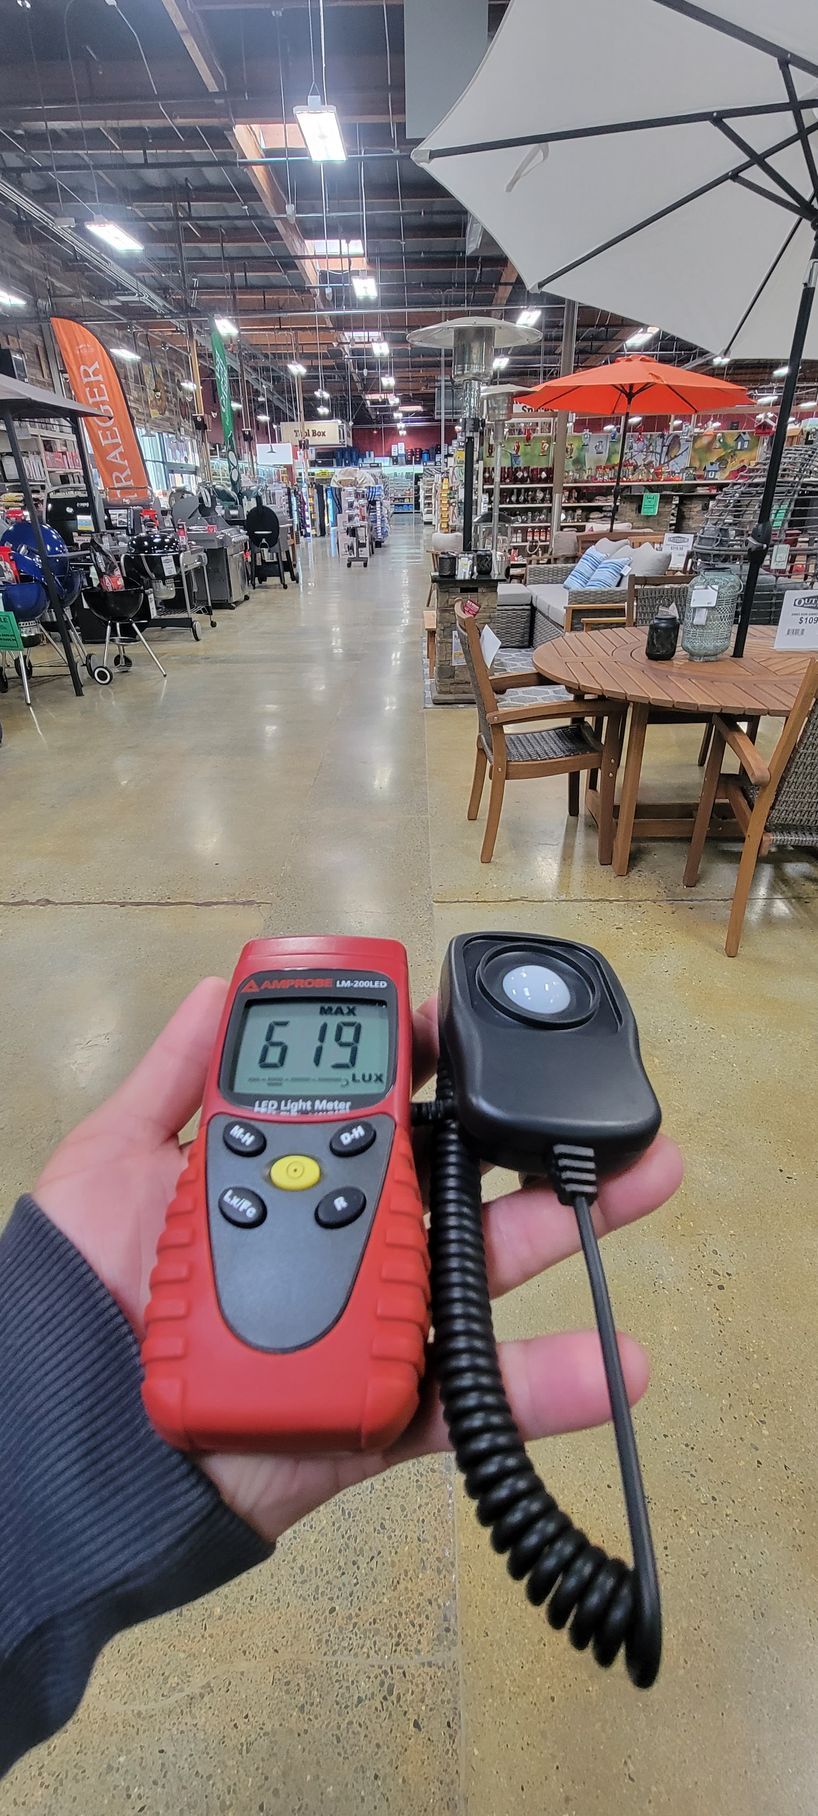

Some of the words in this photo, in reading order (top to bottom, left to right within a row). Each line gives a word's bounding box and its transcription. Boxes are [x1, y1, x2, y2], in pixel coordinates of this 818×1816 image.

[294, 429, 310, 437] Tol
[311, 429, 326, 437] Box
[260, 978, 333, 990] AMPROBE
[336, 980, 388, 988] LM-200LED
[319, 1005, 357, 1016] MAX
[258, 1020, 362, 1069] 619
[352, 1073, 384, 1083] LUX
[254, 1100, 279, 1112] LED
[280, 1099, 312, 1113] Light
[314, 1099, 351, 1112] Meter
[229, 1124, 256, 1146] M-H
[339, 1125, 366, 1146] D-H
[333, 1196, 348, 1211] R
